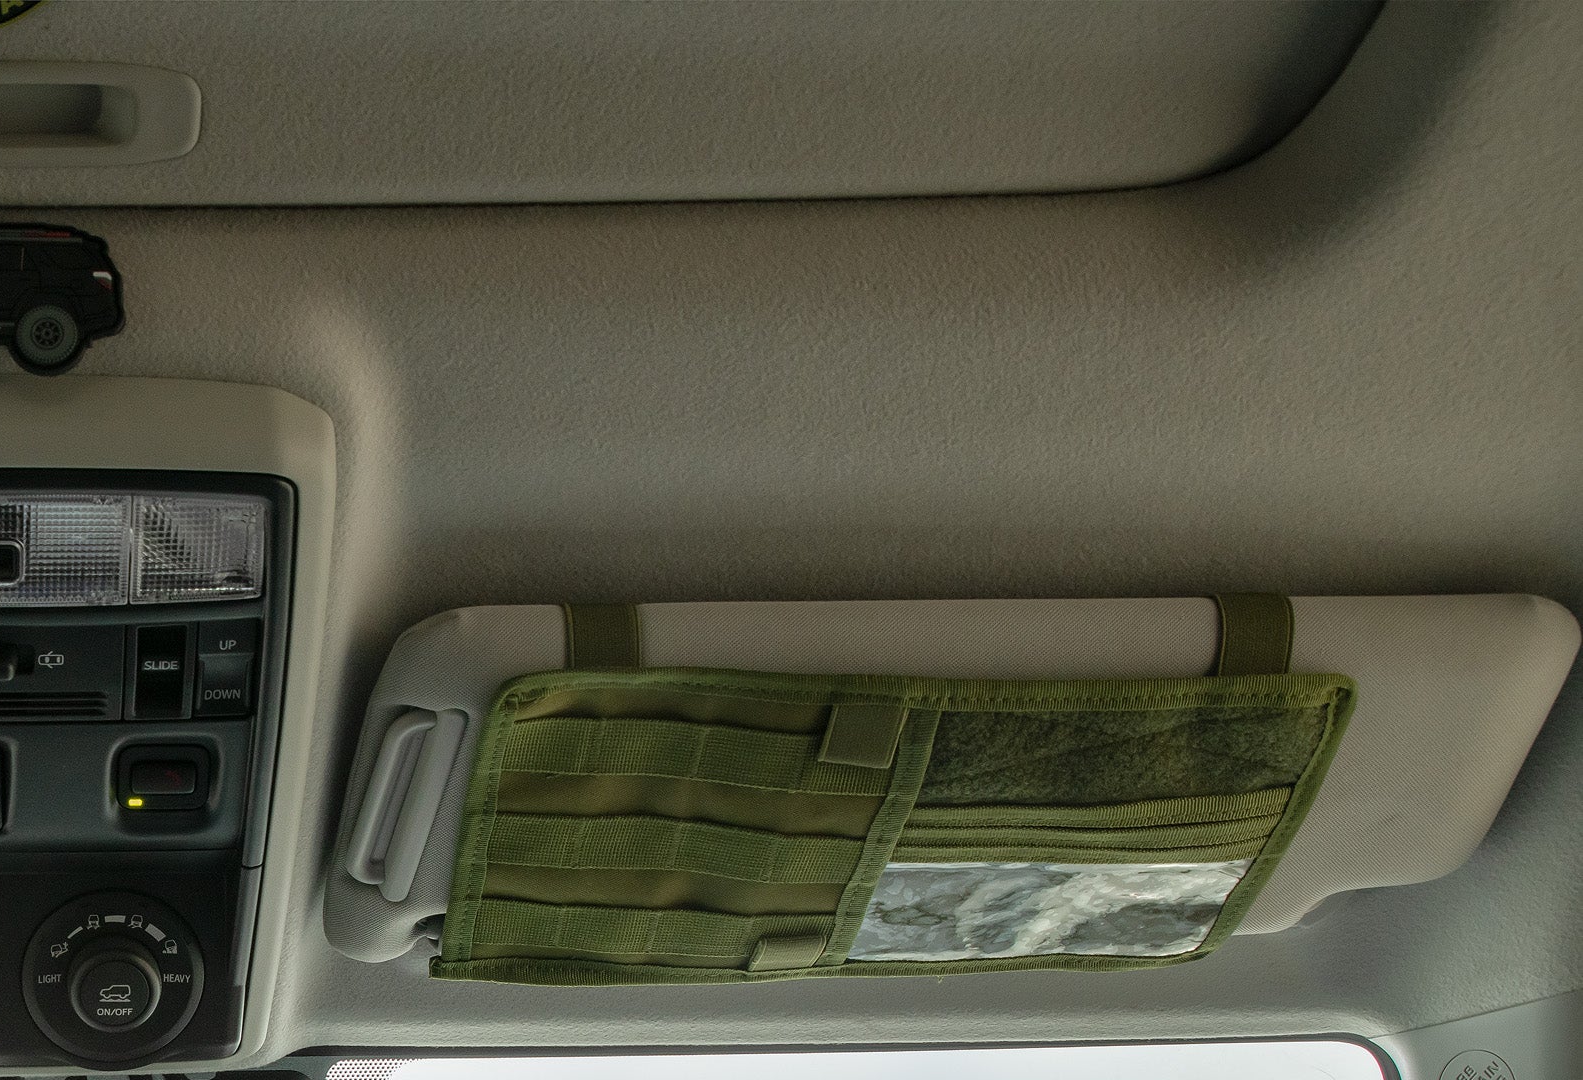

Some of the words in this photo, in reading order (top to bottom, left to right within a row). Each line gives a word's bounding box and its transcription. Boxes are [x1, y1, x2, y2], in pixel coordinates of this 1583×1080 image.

[219, 639, 237, 651] UP
[143, 659, 179, 671] SLIDE
[204, 688, 241, 702] DOWN
[38, 974, 61, 984] LIGHT
[163, 973, 191, 984] HEAVY
[96, 1007, 134, 1017] ON/OFF
